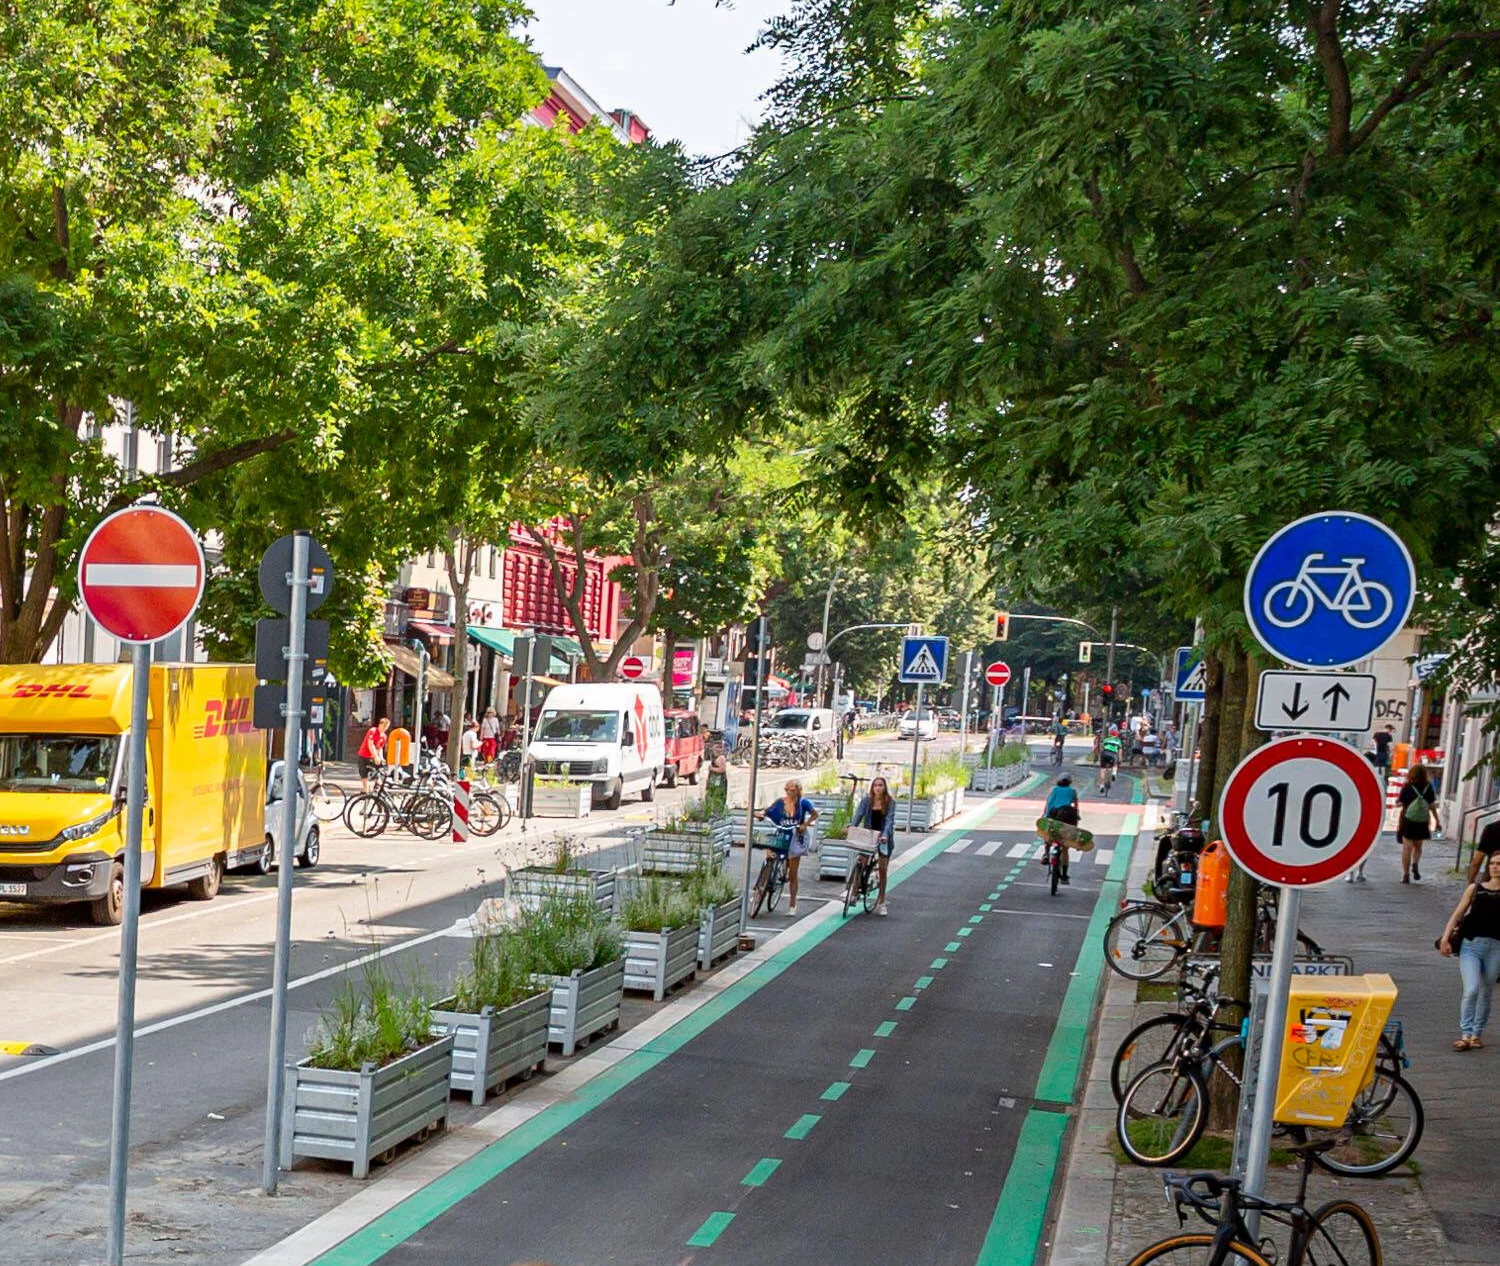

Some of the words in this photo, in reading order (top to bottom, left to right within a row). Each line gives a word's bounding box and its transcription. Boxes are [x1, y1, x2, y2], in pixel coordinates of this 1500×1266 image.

[11, 683, 92, 699] DHL
[203, 697, 253, 738] DHL
[1267, 781, 1342, 849] 10
